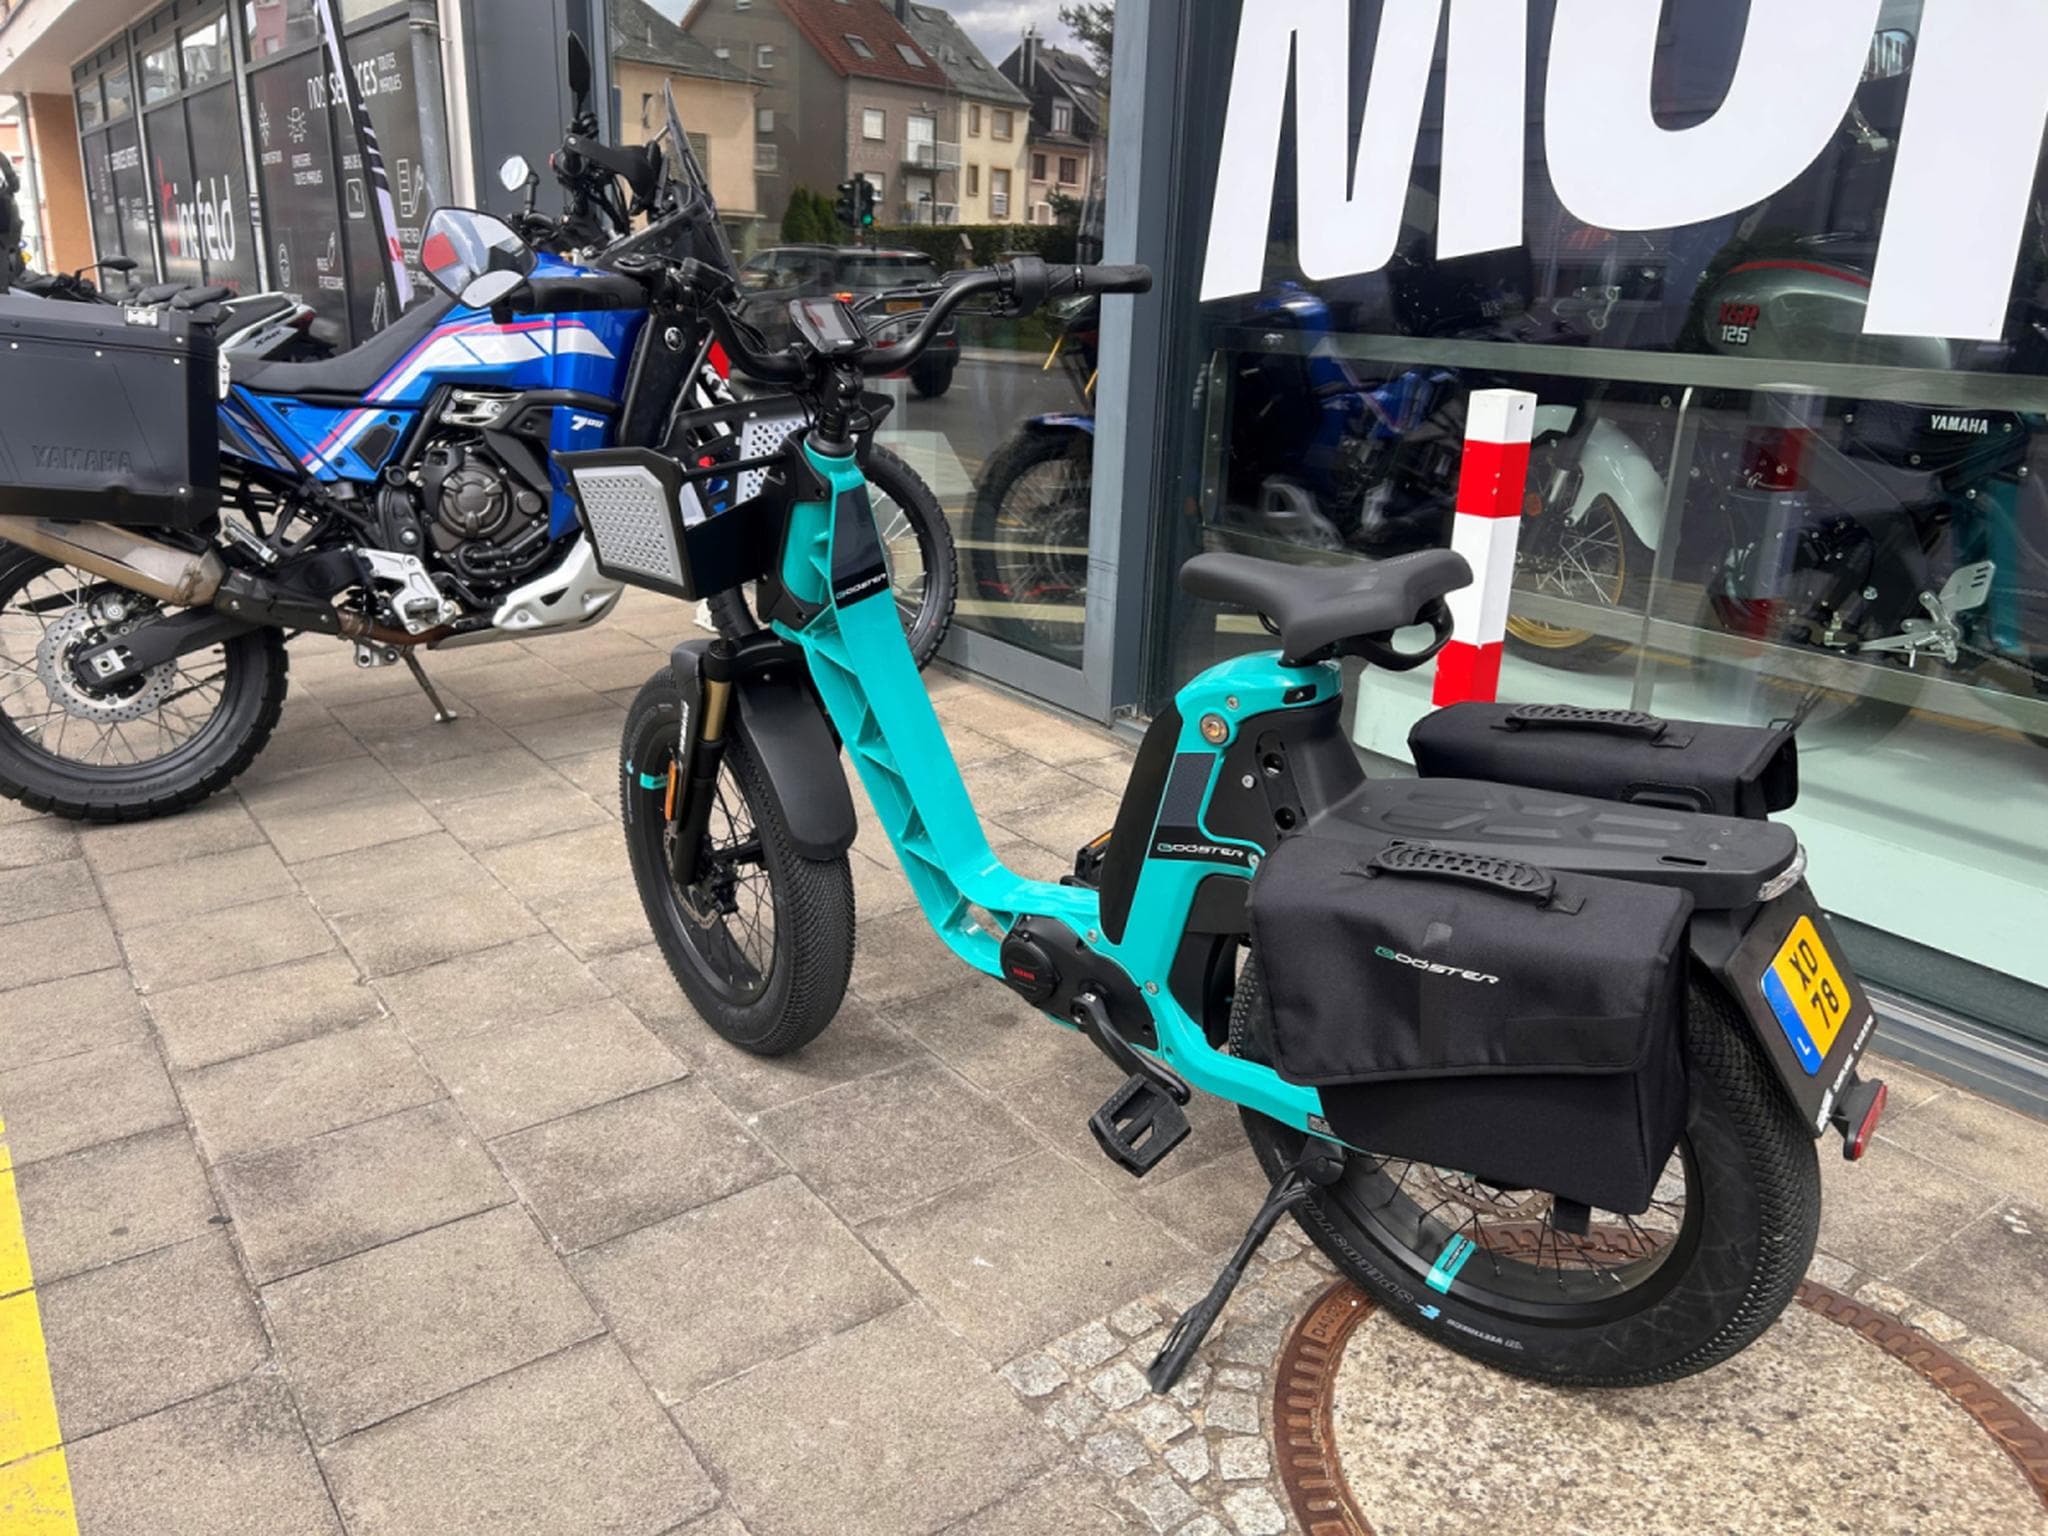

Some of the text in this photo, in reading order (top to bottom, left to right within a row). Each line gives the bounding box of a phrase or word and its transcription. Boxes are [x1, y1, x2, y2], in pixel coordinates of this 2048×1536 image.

[1721, 325, 1750, 343] 125
[1931, 414, 1988, 434] YAMAHA
[31, 445, 135, 474] YAMAHA
[1789, 938, 1818, 992] XD
[1810, 977, 1840, 1030] 78
